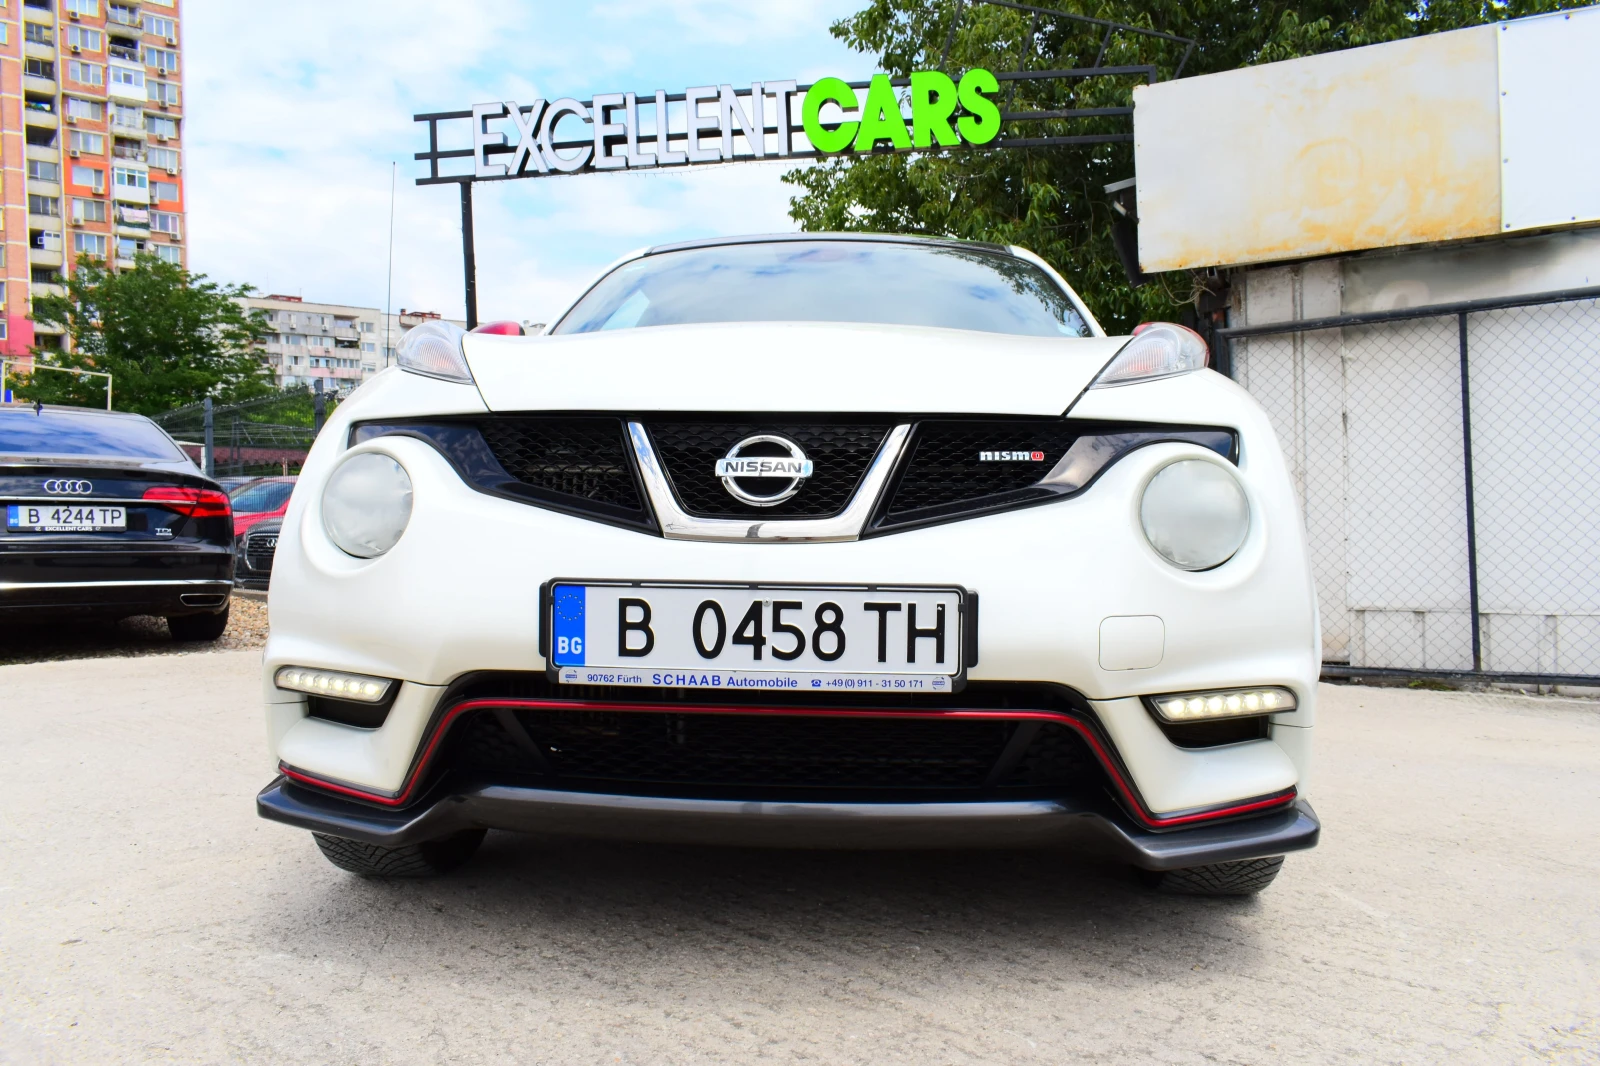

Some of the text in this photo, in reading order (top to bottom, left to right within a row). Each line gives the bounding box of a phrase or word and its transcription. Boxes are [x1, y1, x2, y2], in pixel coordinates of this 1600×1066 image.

[725, 461, 802, 474] NISSAN
[28, 508, 122, 524] B 4244 TP
[618, 597, 945, 663] B 0458 TH
[557, 636, 583, 655] BG
[587, 673, 614, 683] 90762
[617, 674, 642, 683] Fürth
[652, 673, 721, 686] SCHAAB
[726, 676, 798, 688] Automobile
[857, 679, 872, 688] 911
[909, 680, 923, 688] 171
